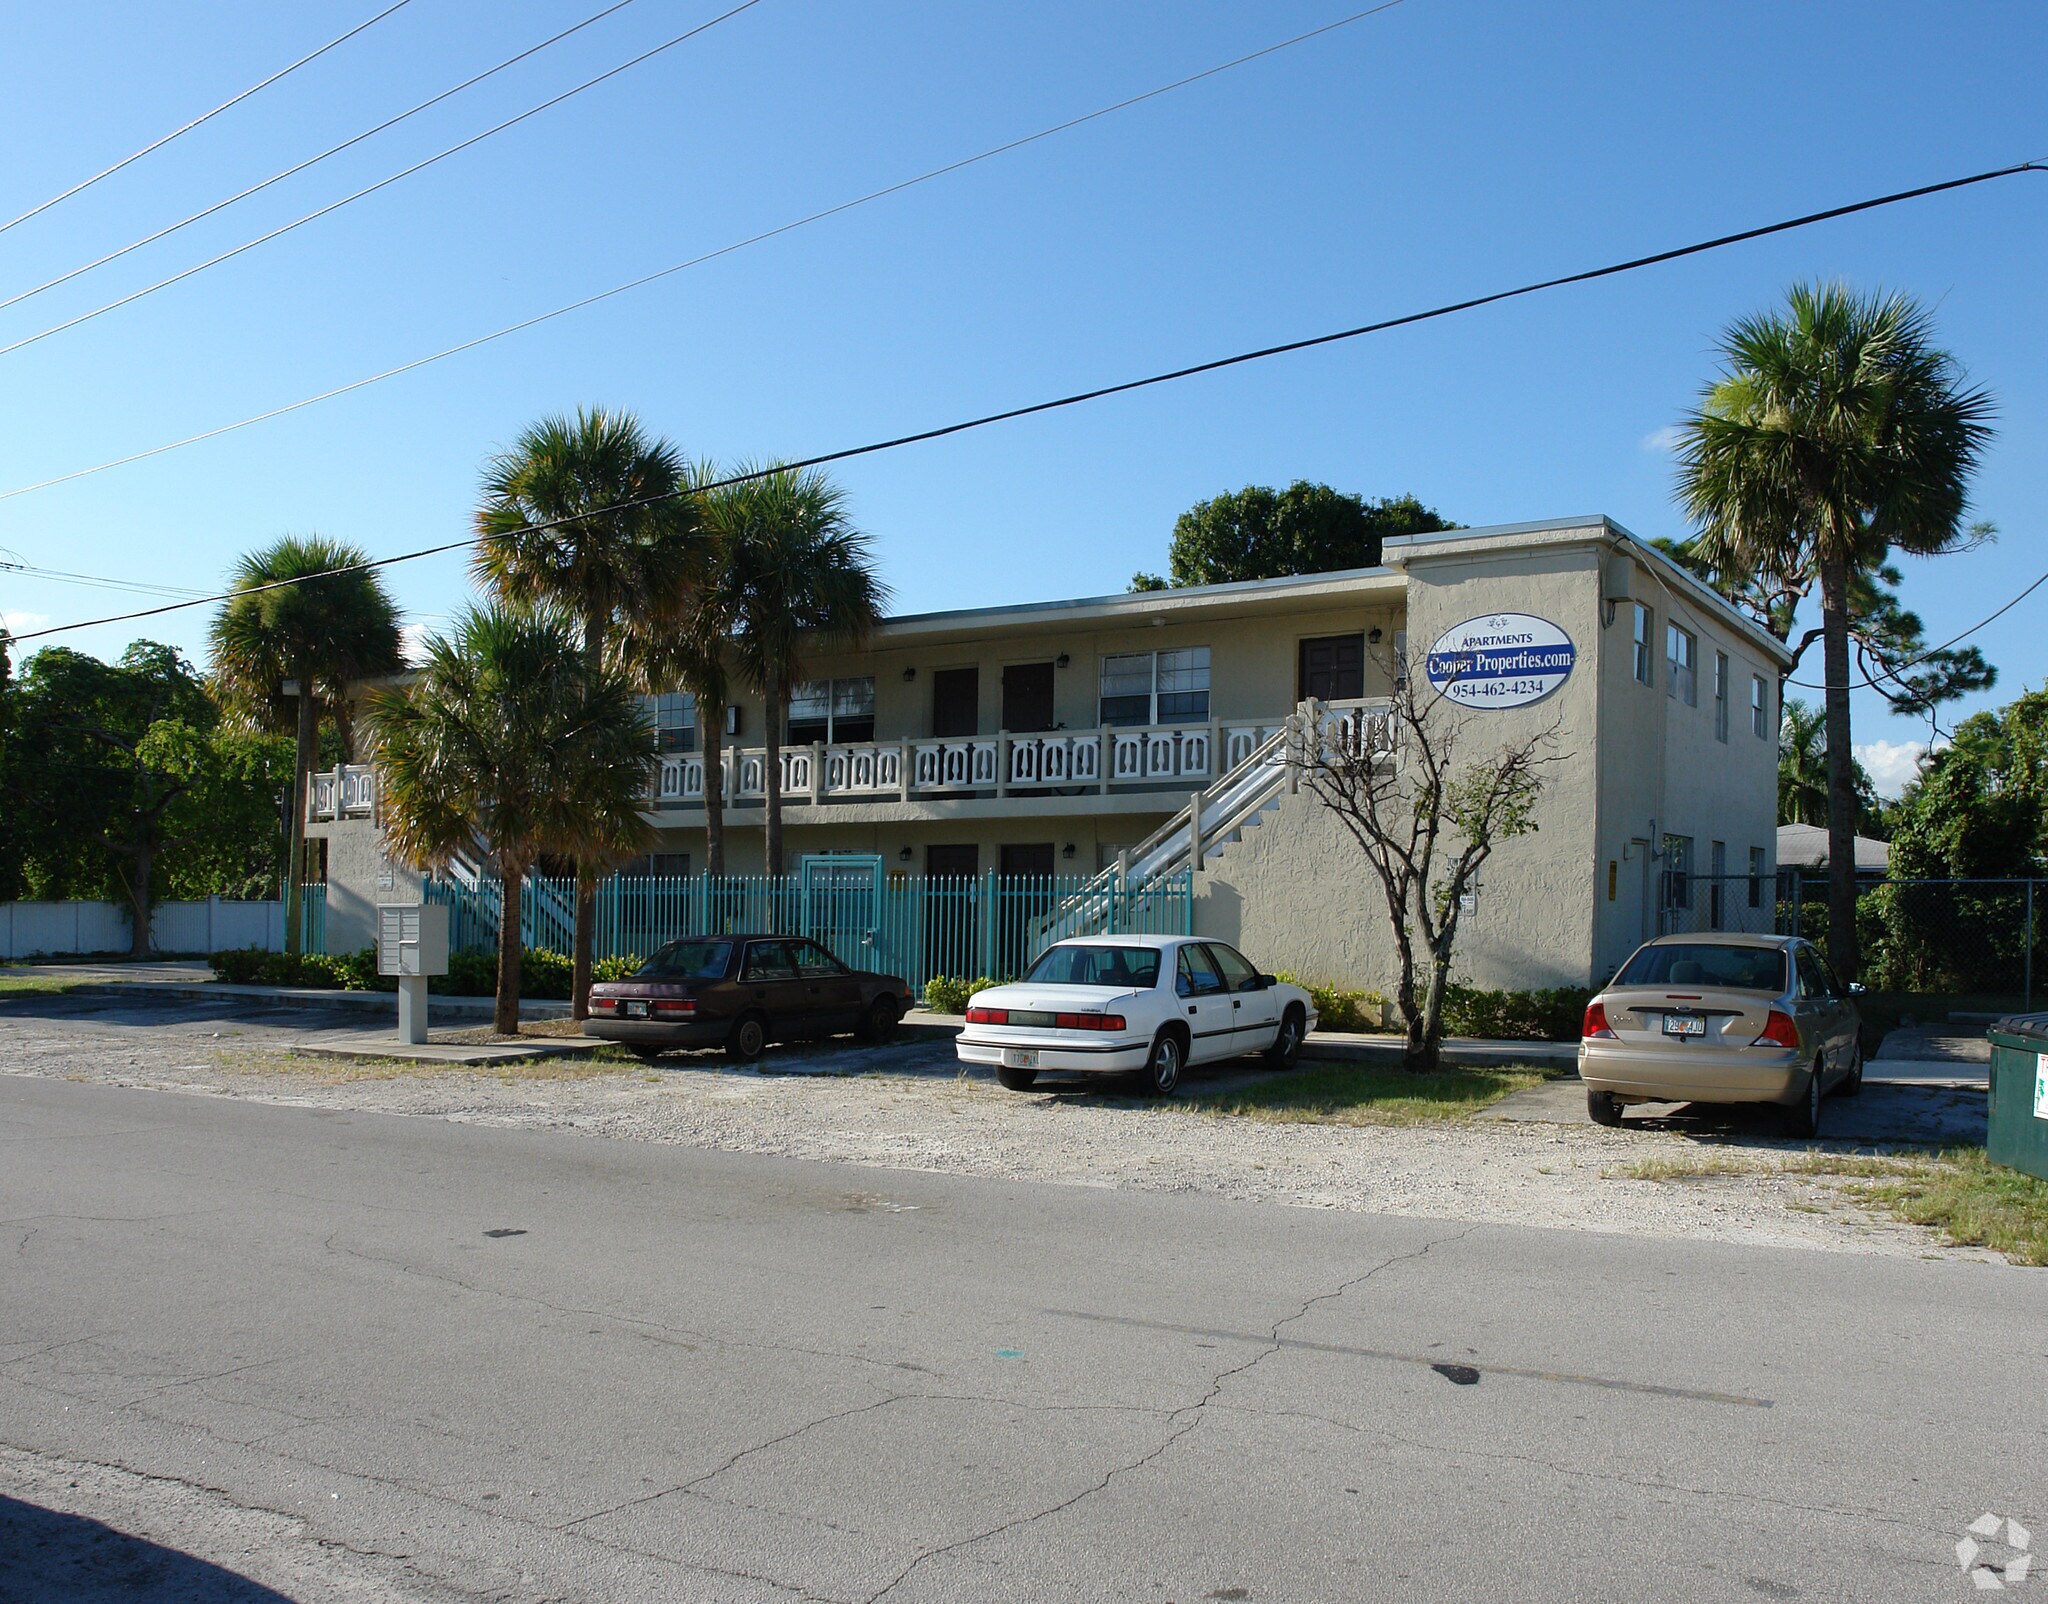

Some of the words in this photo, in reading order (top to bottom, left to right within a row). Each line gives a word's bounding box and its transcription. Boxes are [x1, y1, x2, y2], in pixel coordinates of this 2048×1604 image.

[1462, 633, 1533, 647] APARTMENTS
[1429, 656, 1473, 675] Cooper
[1476, 651, 1571, 675] Properties.com
[1453, 680, 1543, 698] 954-462-4234
